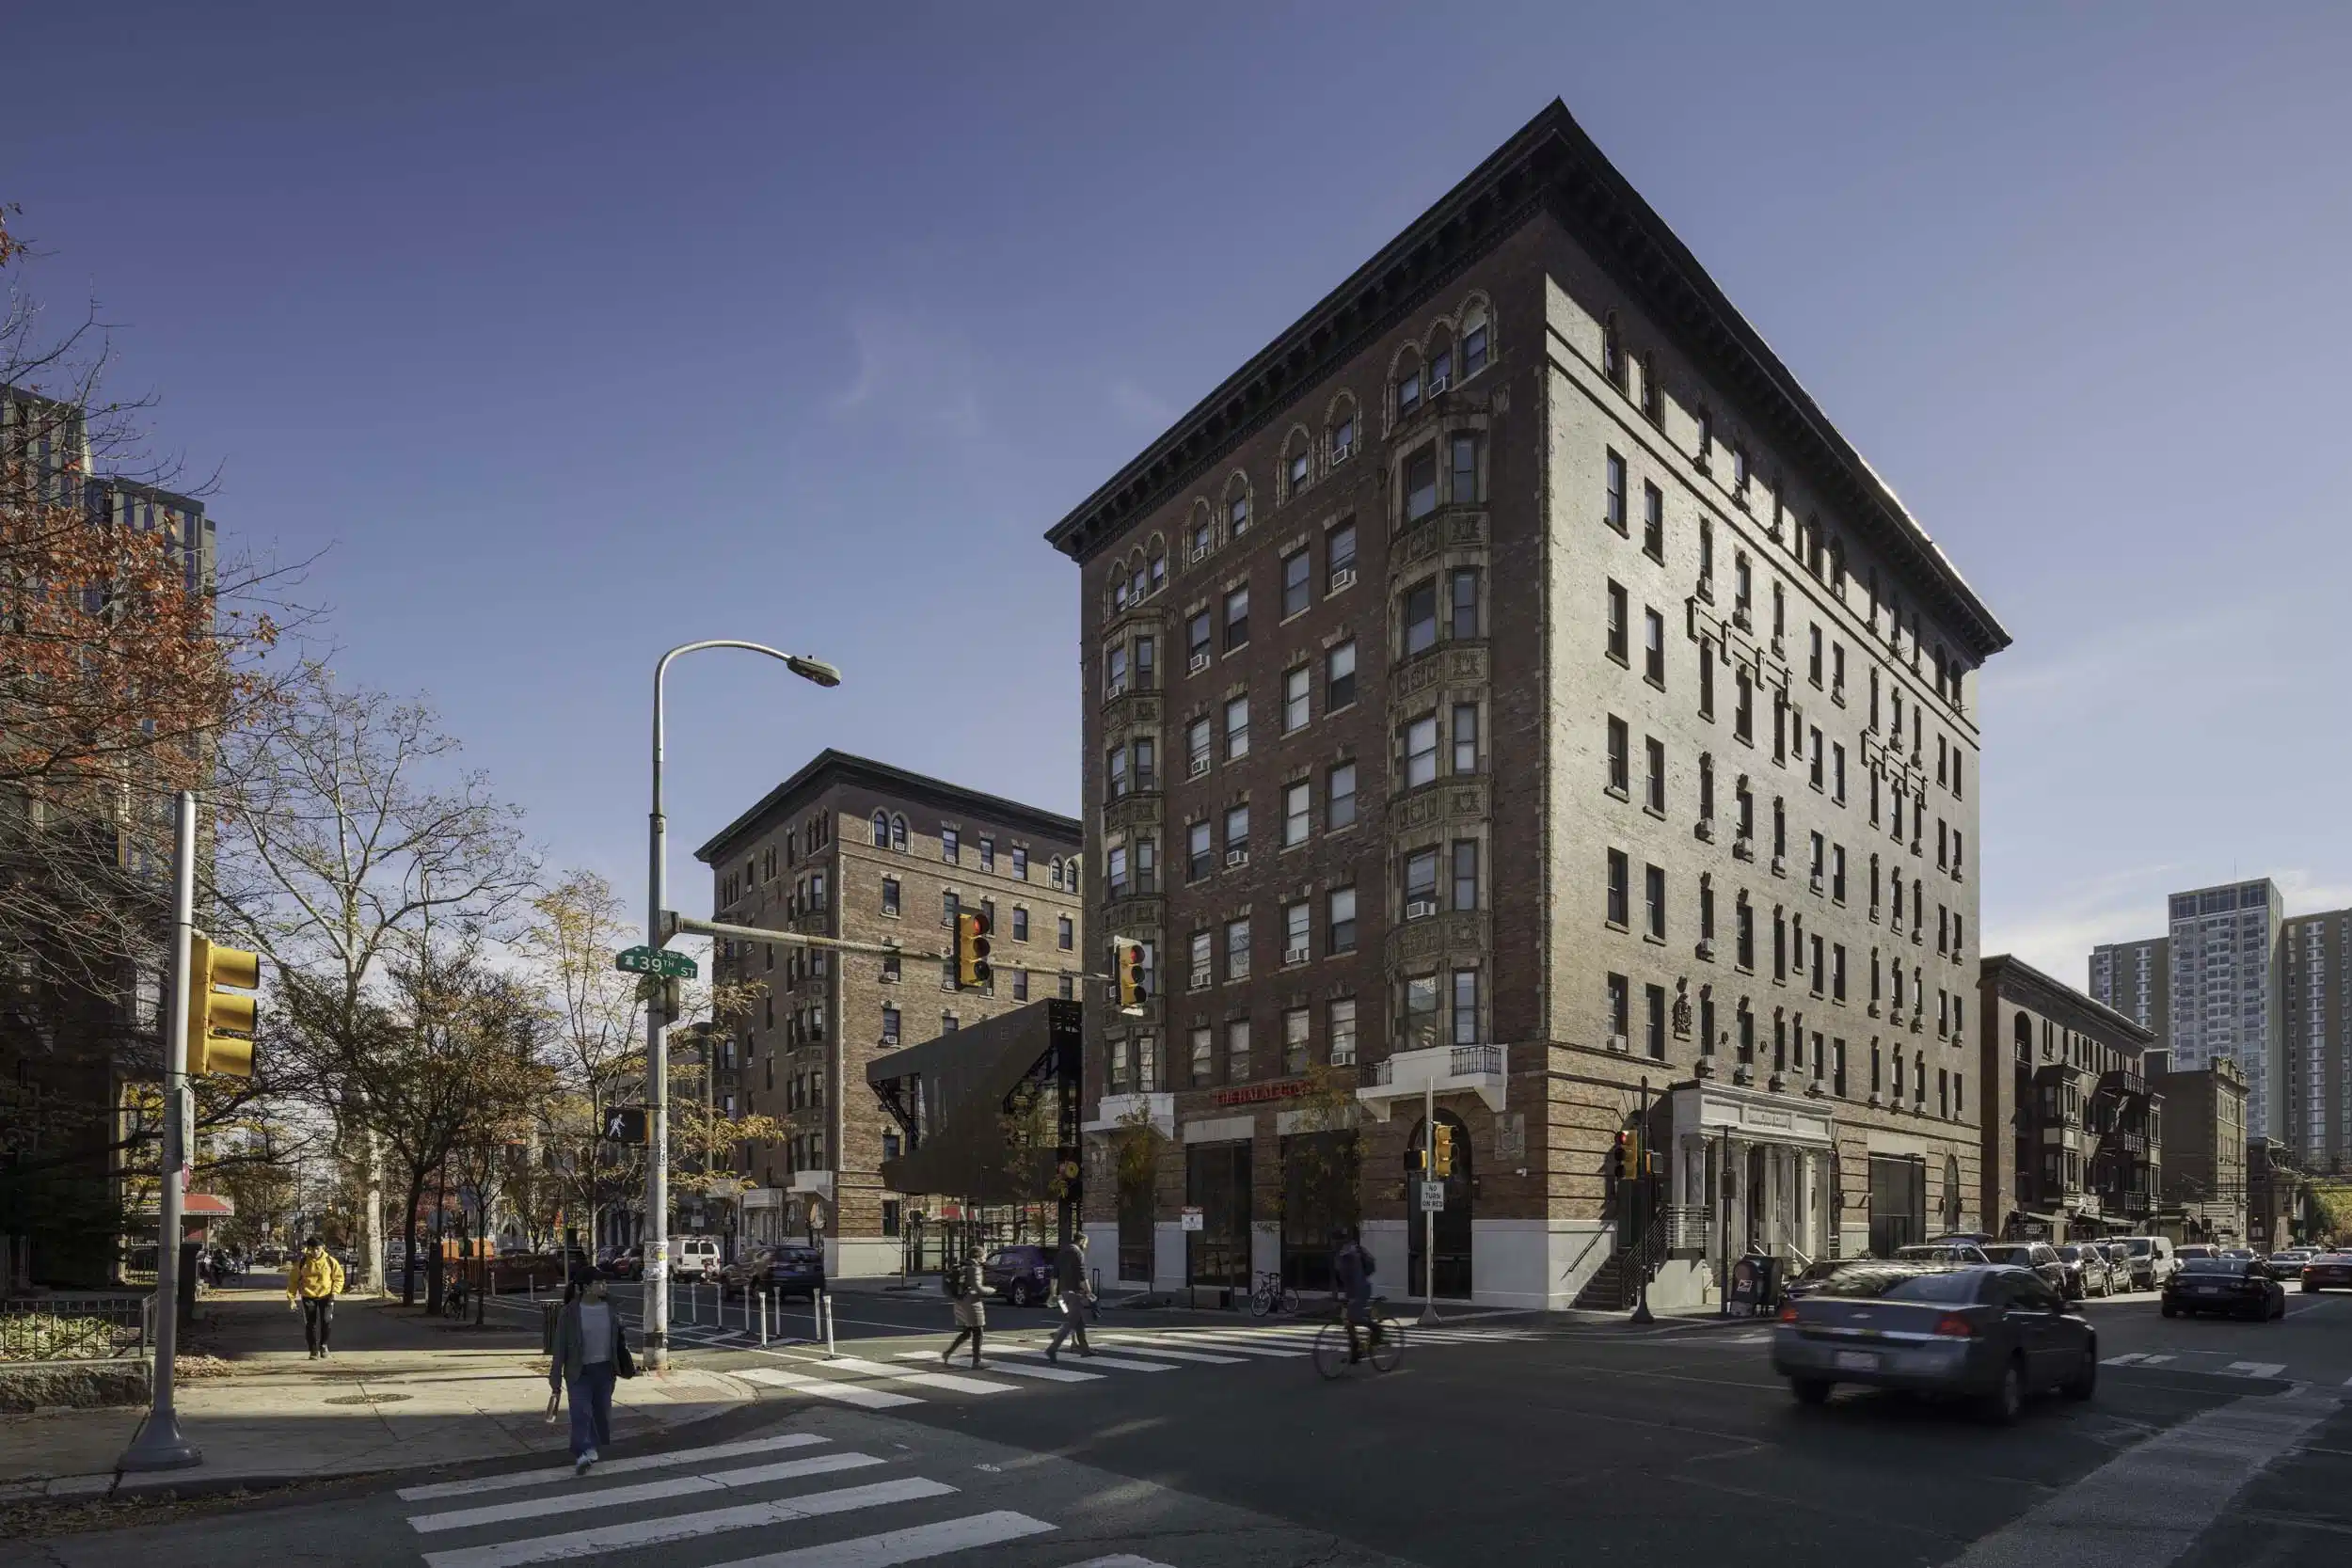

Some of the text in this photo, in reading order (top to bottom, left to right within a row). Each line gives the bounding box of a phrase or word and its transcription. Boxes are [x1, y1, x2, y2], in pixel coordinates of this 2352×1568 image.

[657, 949, 663, 958] S
[639, 956, 695, 977] 39TH ST
[1238, 1083, 1277, 1103] HALAL
